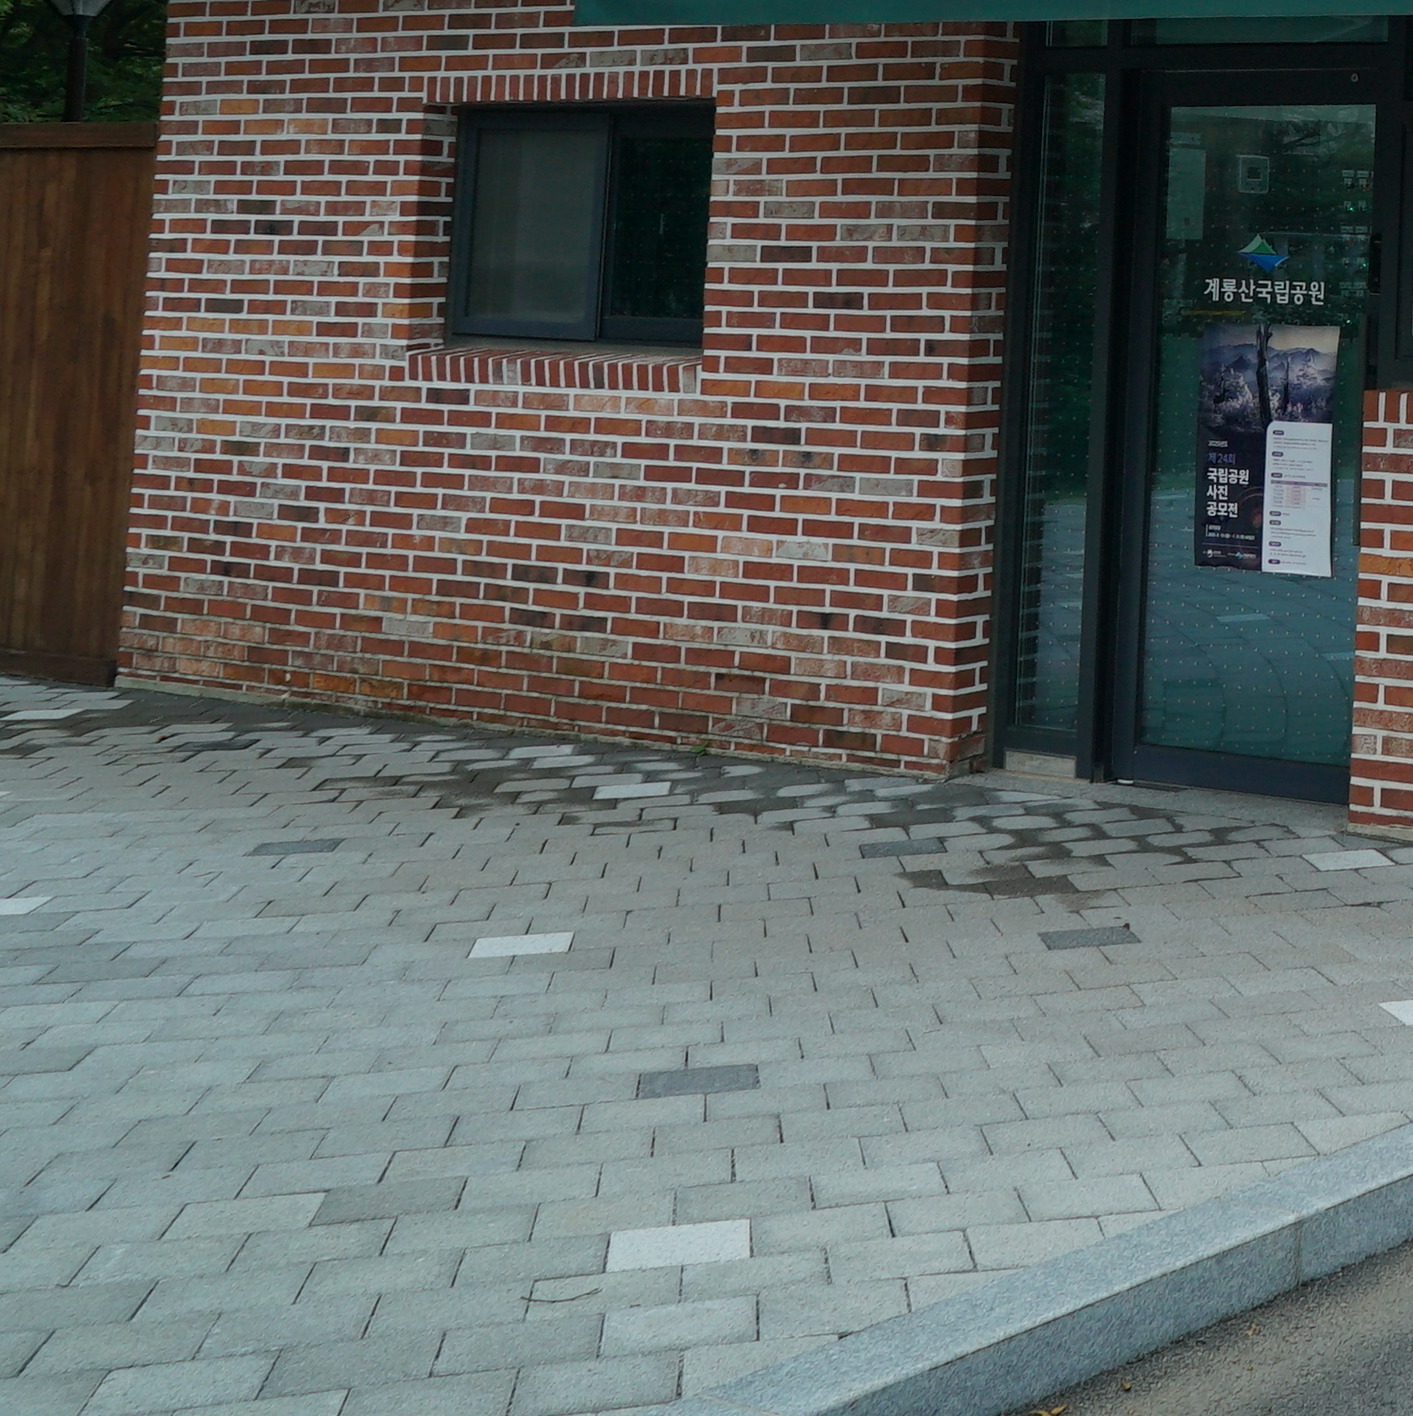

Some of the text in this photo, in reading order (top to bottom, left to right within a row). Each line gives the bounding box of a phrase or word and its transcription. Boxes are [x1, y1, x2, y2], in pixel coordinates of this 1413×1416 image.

[1203, 277, 1326, 306] 계룡산국립공원
[1206, 467, 1250, 485] 국립공원
[1206, 484, 1228, 500] 사진
[1206, 501, 1239, 518] 공모전
